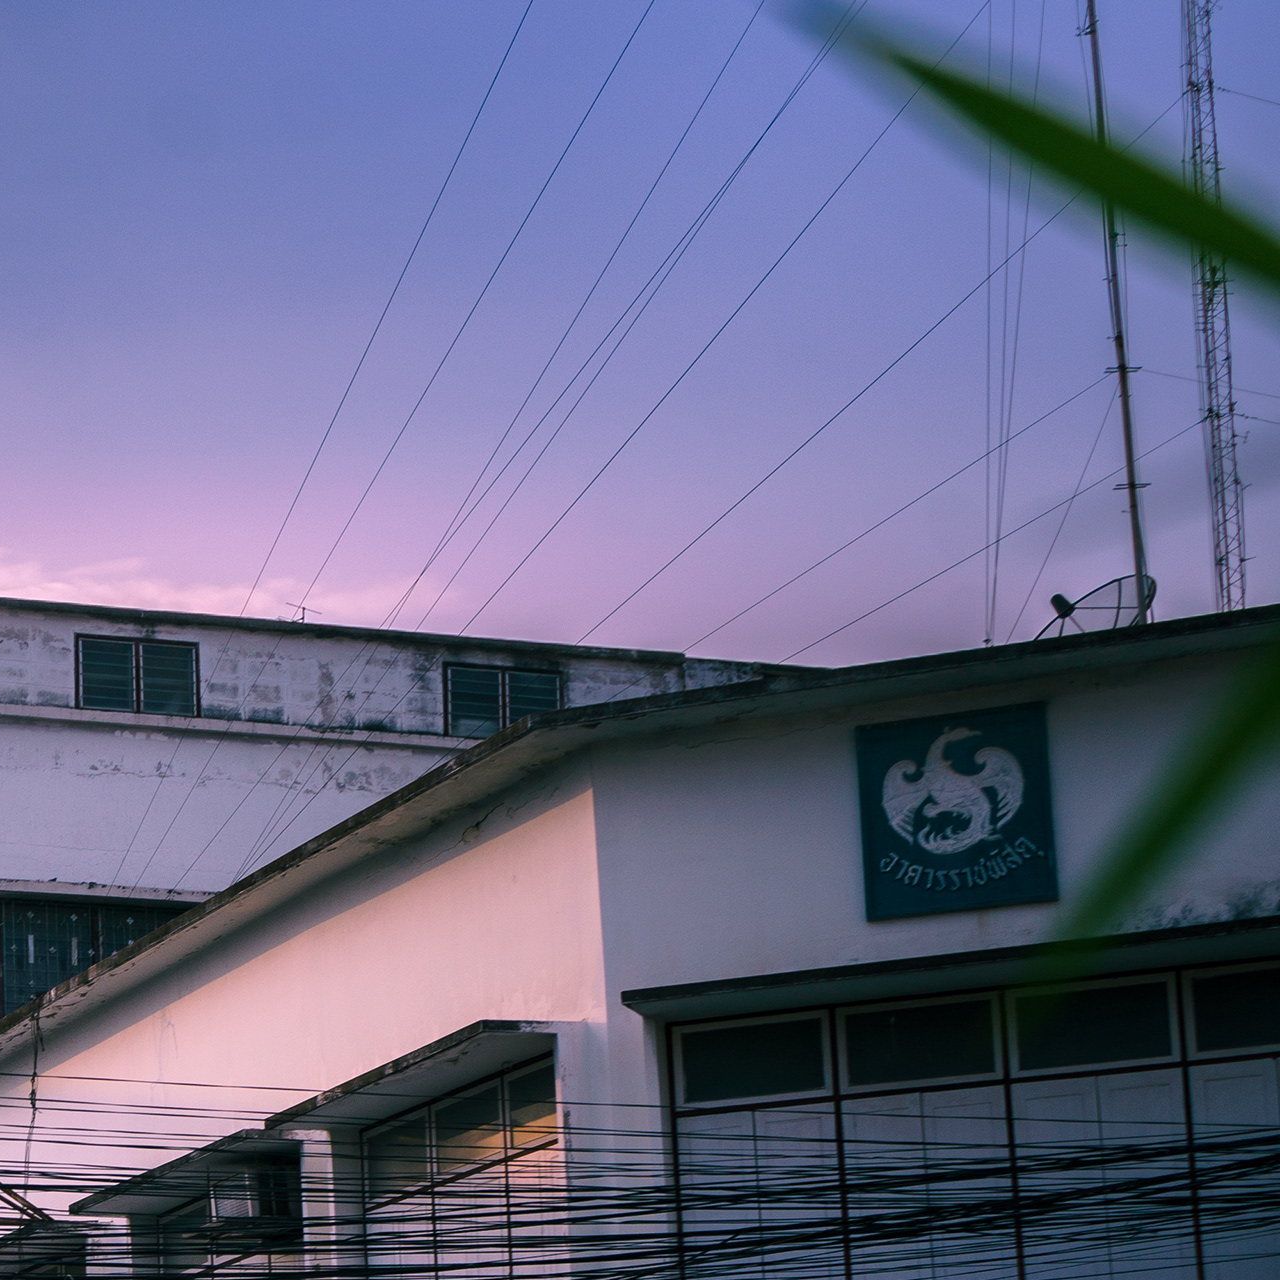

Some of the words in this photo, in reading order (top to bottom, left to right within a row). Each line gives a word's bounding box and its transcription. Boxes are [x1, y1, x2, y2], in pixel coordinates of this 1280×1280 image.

[880, 836, 1045, 892] อาคารราชพัสดุ
